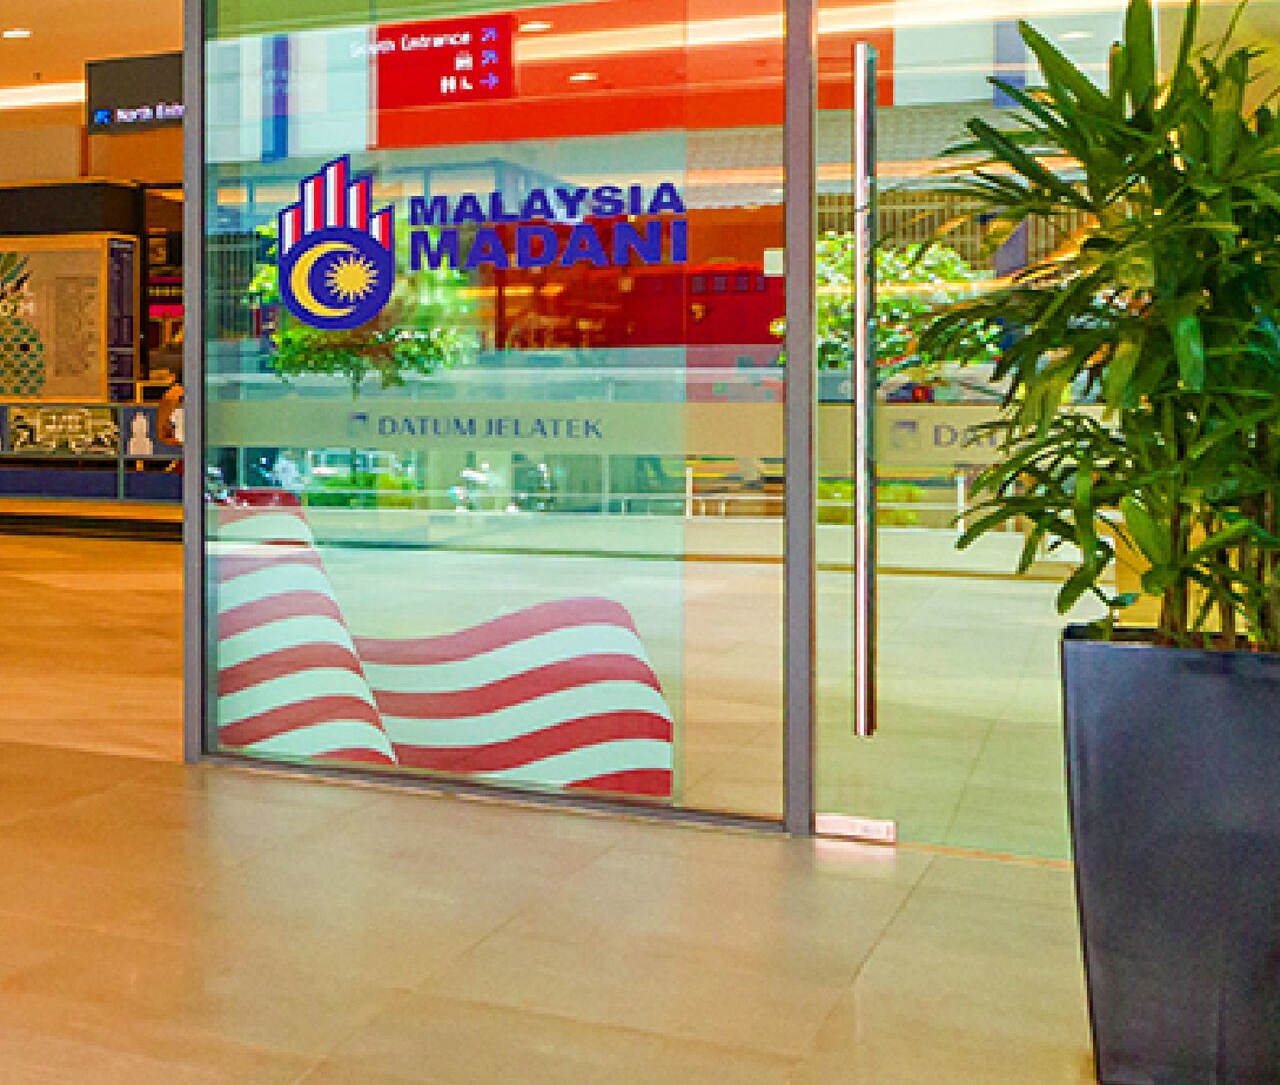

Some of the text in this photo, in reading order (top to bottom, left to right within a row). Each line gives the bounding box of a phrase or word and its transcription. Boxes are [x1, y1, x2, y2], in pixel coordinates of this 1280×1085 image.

[401, 32, 471, 51] Entrance
[115, 107, 153, 123] North
[408, 182, 686, 227] MALAYSIA
[408, 219, 688, 271] MADANI
[378, 417, 603, 440] DATUM JELATEK
